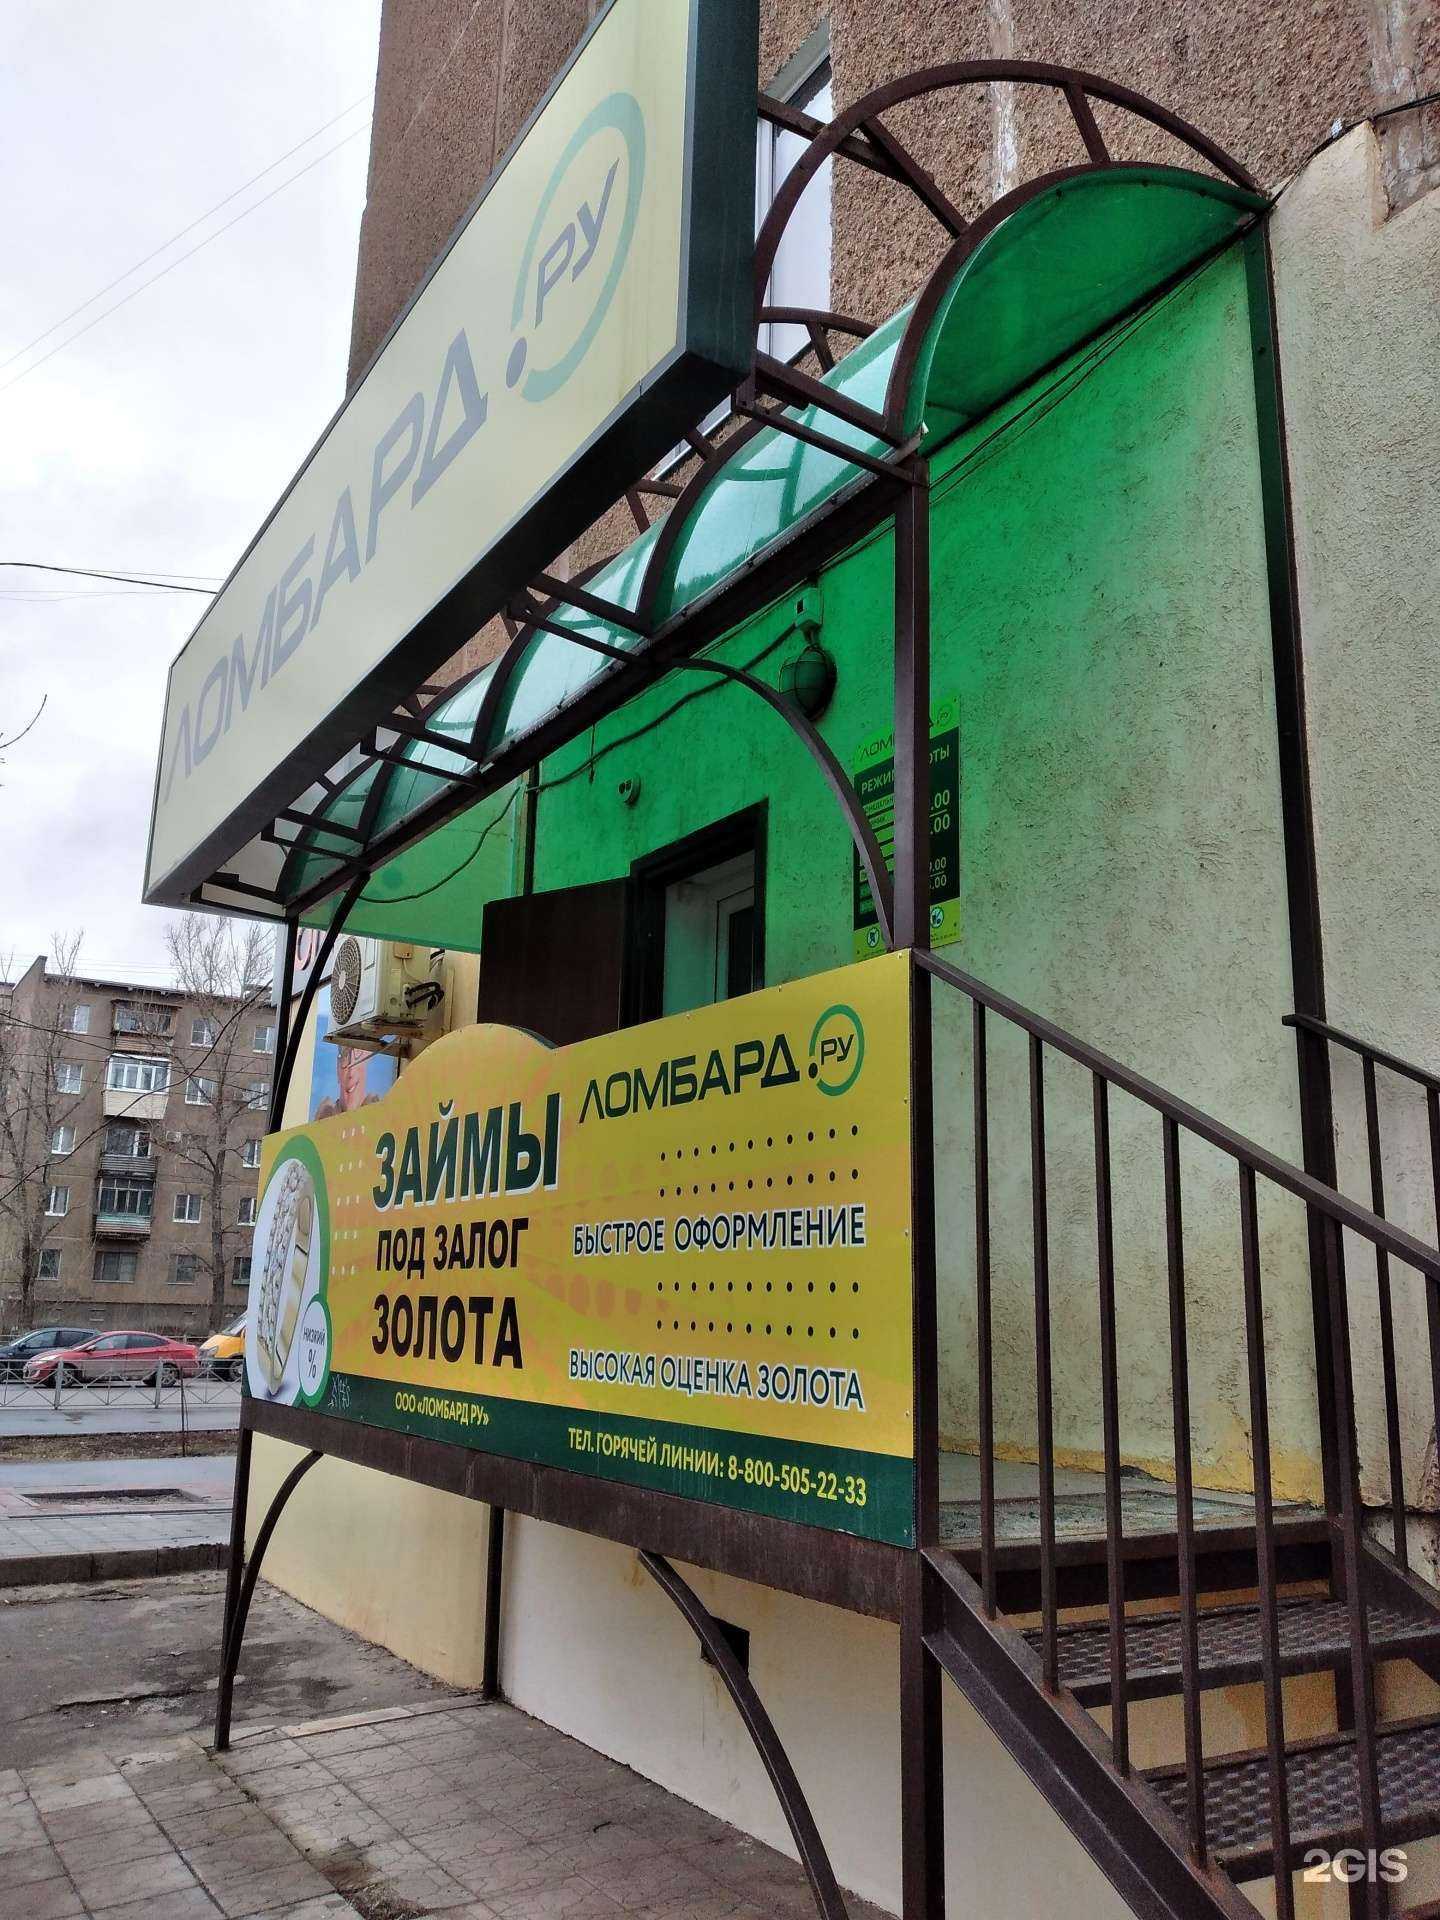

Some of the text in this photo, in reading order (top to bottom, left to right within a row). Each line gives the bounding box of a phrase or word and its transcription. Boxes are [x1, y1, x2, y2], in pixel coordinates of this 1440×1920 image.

[372, 1092, 561, 1212] ЗАЙМЫ
[376, 1218, 529, 1280] ПОД ЗАЛОГ
[573, 1204, 867, 1257] БЫСТРОЕ ОФОРМЛЕНИЕ
[371, 1293, 523, 1369] ЗОЛОТА
[395, 1391, 416, 1412] ООО
[568, 1350, 867, 1412] ВЫСОКАЯ ОЦЕНКА ЗОЛОТА
[568, 1426, 868, 1507] ТЕЛ. ГОРЯЧЕЙ ЛИНИИ: 8-800-505-22-33
